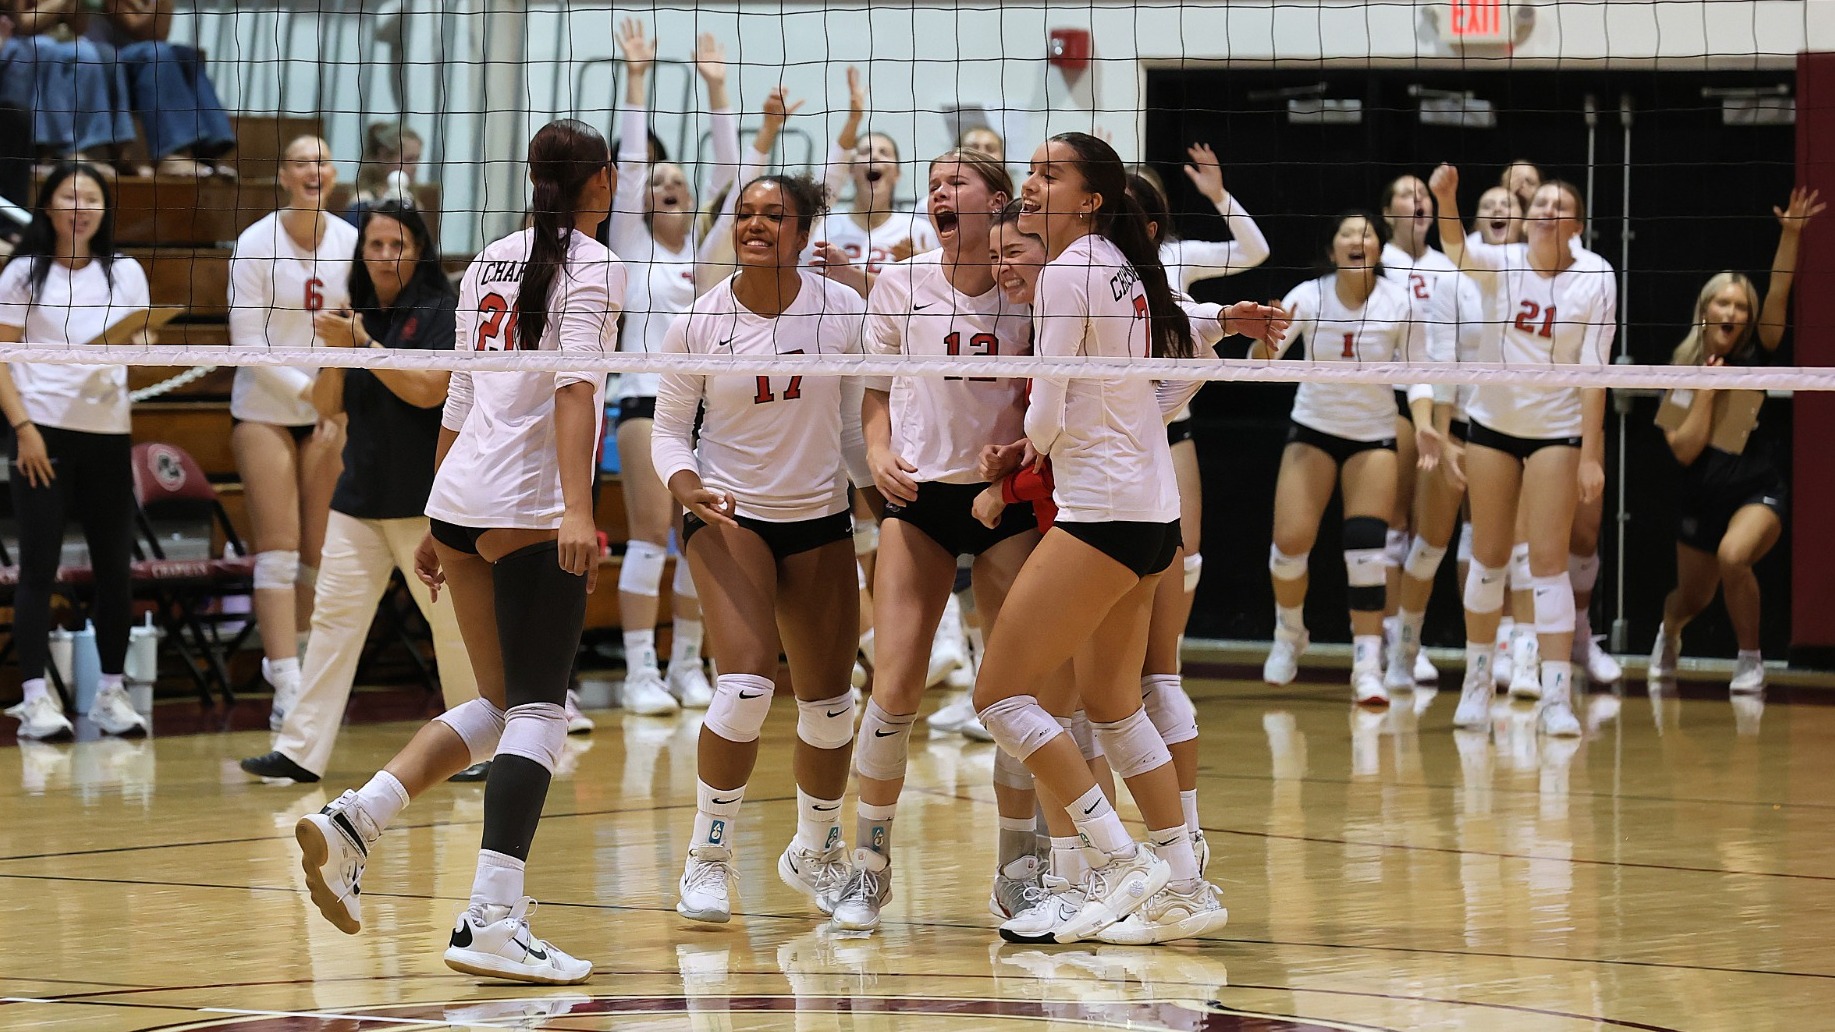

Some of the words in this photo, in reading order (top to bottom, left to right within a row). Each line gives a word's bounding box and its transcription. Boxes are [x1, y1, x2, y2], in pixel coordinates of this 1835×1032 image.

[1451, 0, 1500, 35] EXIT
[303, 277, 324, 311] 6
[1514, 299, 1554, 339] 21
[1341, 331, 1354, 358] 1
